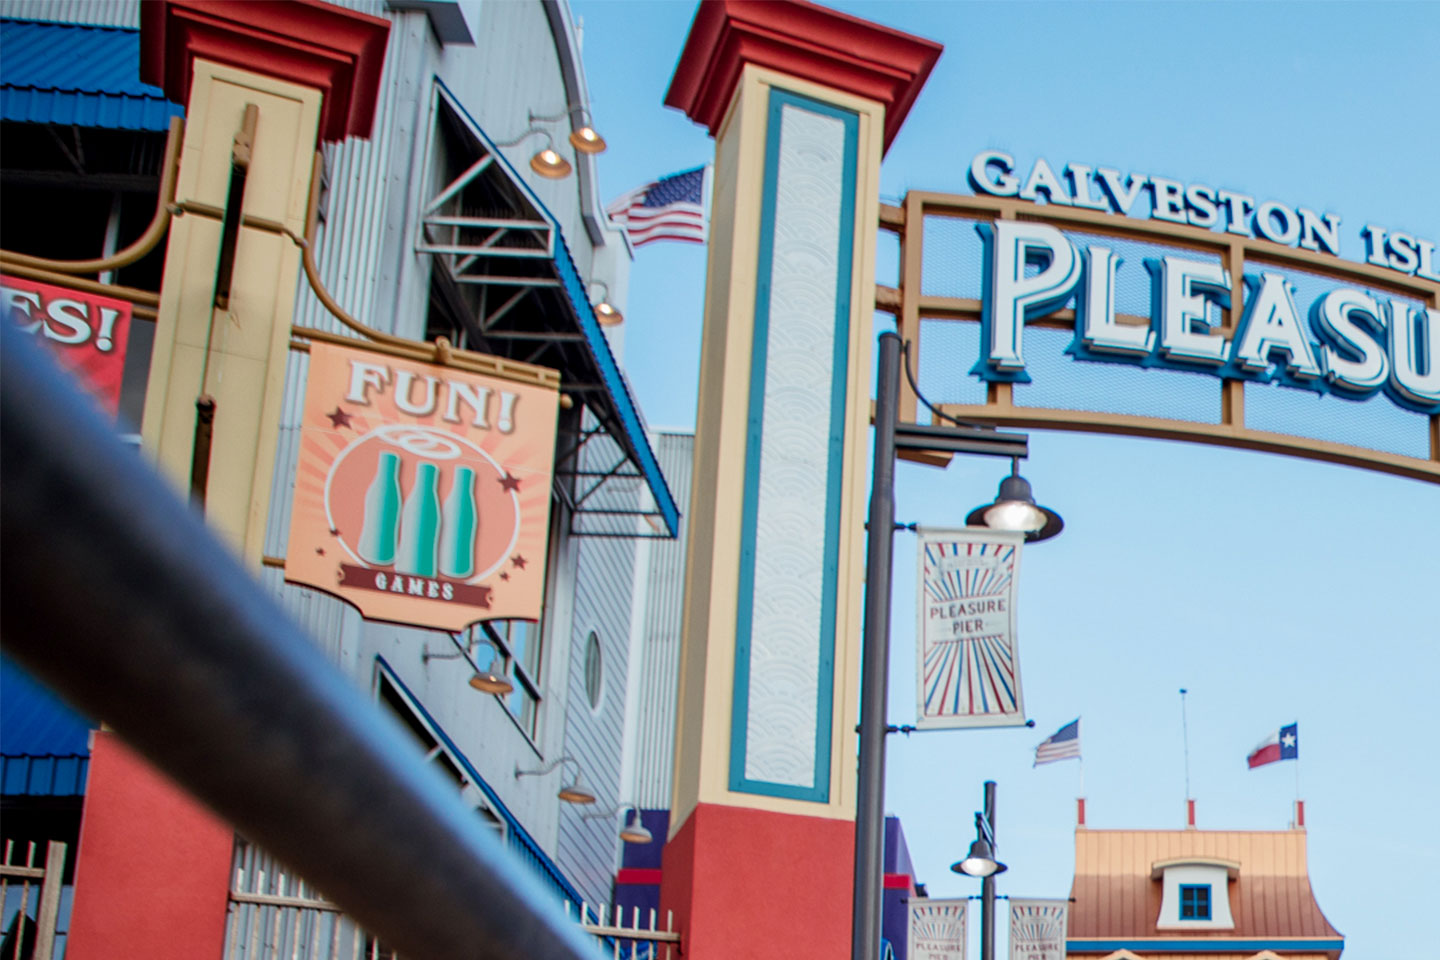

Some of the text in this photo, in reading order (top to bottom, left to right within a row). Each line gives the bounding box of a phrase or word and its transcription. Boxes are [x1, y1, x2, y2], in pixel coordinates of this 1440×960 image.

[969, 151, 1341, 255] GALVESTON
[346, 359, 521, 434] FUN!
[374, 571, 455, 601] GAMES
[930, 599, 1006, 619] PLEASURE
[953, 619, 984, 635] PIER
